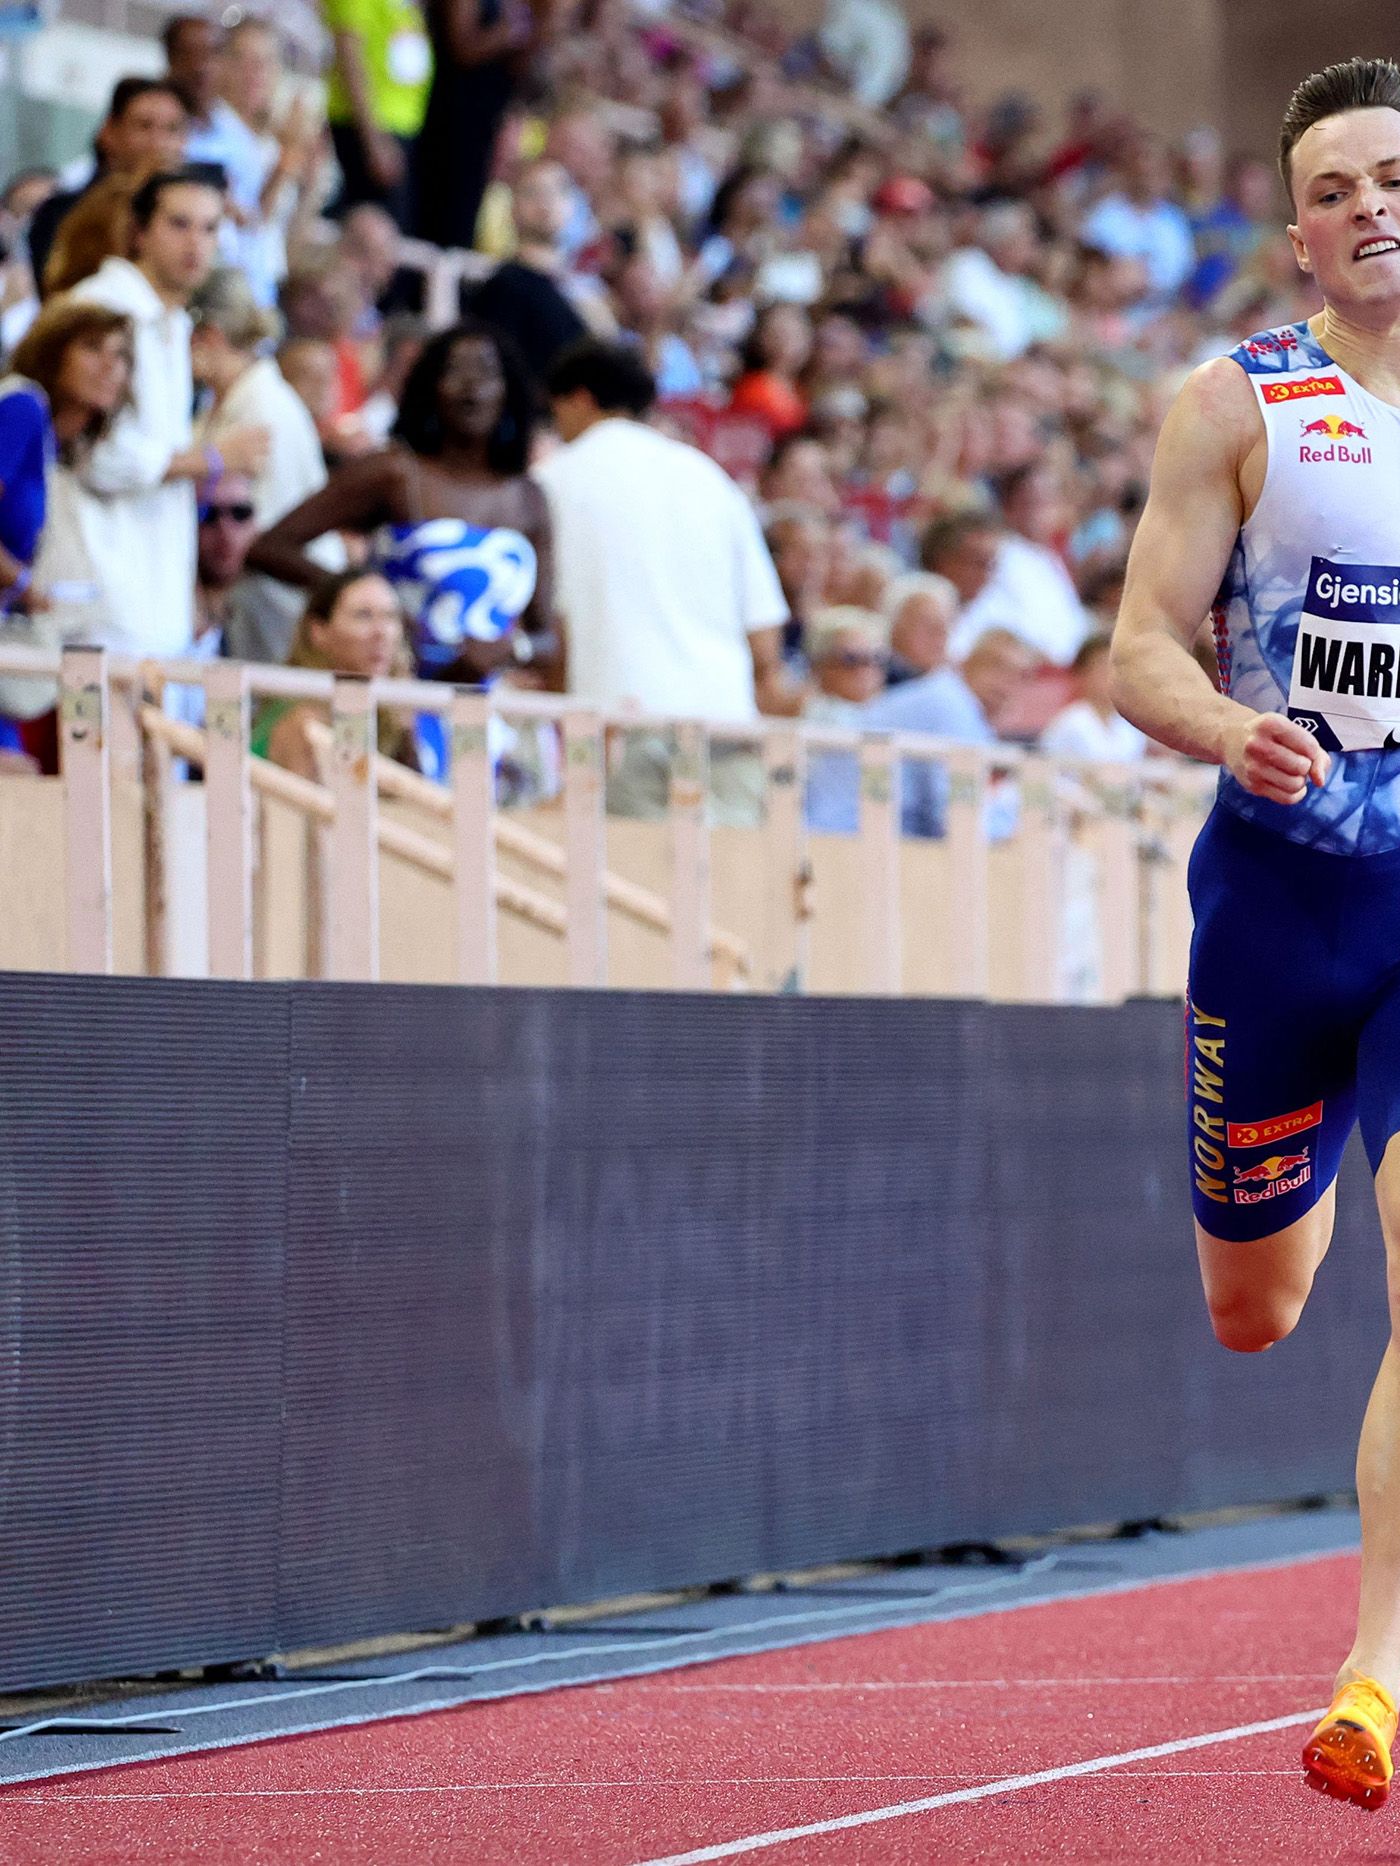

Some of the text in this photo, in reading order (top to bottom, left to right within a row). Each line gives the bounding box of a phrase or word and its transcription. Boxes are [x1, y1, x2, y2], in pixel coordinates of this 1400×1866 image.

[1292, 381, 1336, 394] EXTRA
[1299, 444, 1372, 464] Red Bull
[1193, 1001, 1228, 1204] NORWAY
[1263, 1113, 1315, 1137] EXTRA
[1233, 1165, 1311, 1205] Red Bull
